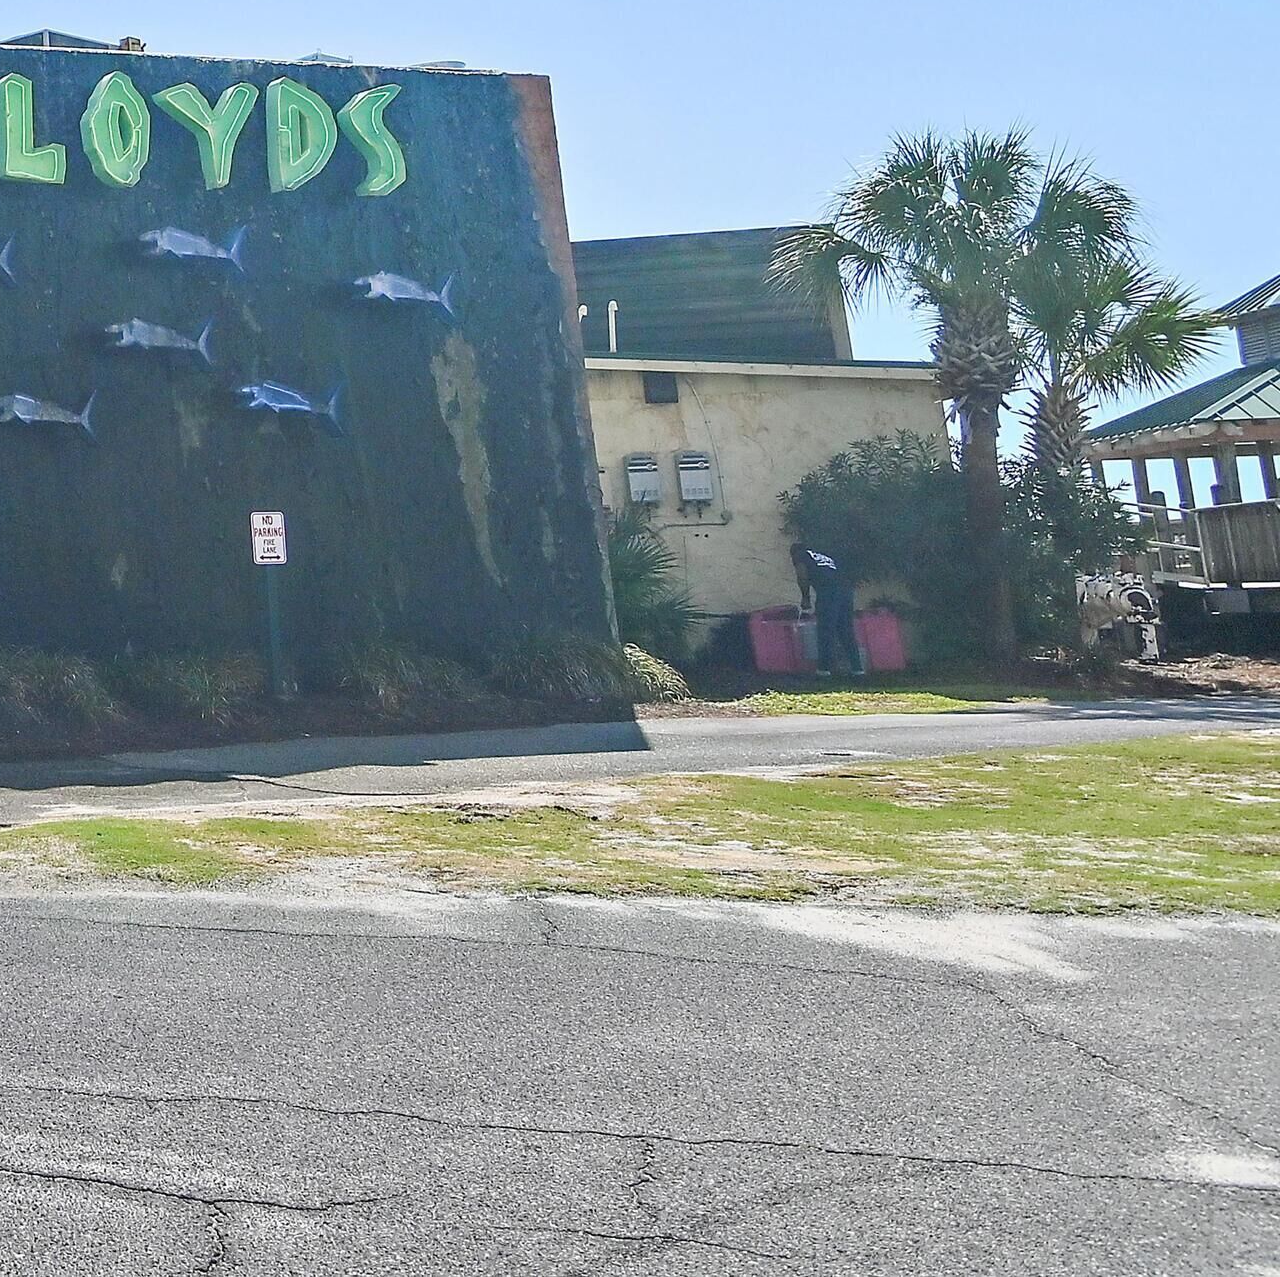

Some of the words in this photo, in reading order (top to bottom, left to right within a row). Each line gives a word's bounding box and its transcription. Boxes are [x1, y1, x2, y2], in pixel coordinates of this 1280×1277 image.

[262, 515, 274, 525] NO
[253, 526, 284, 537] PARKING
[263, 538, 276, 546] FIRE
[262, 546, 277, 554] LANE
